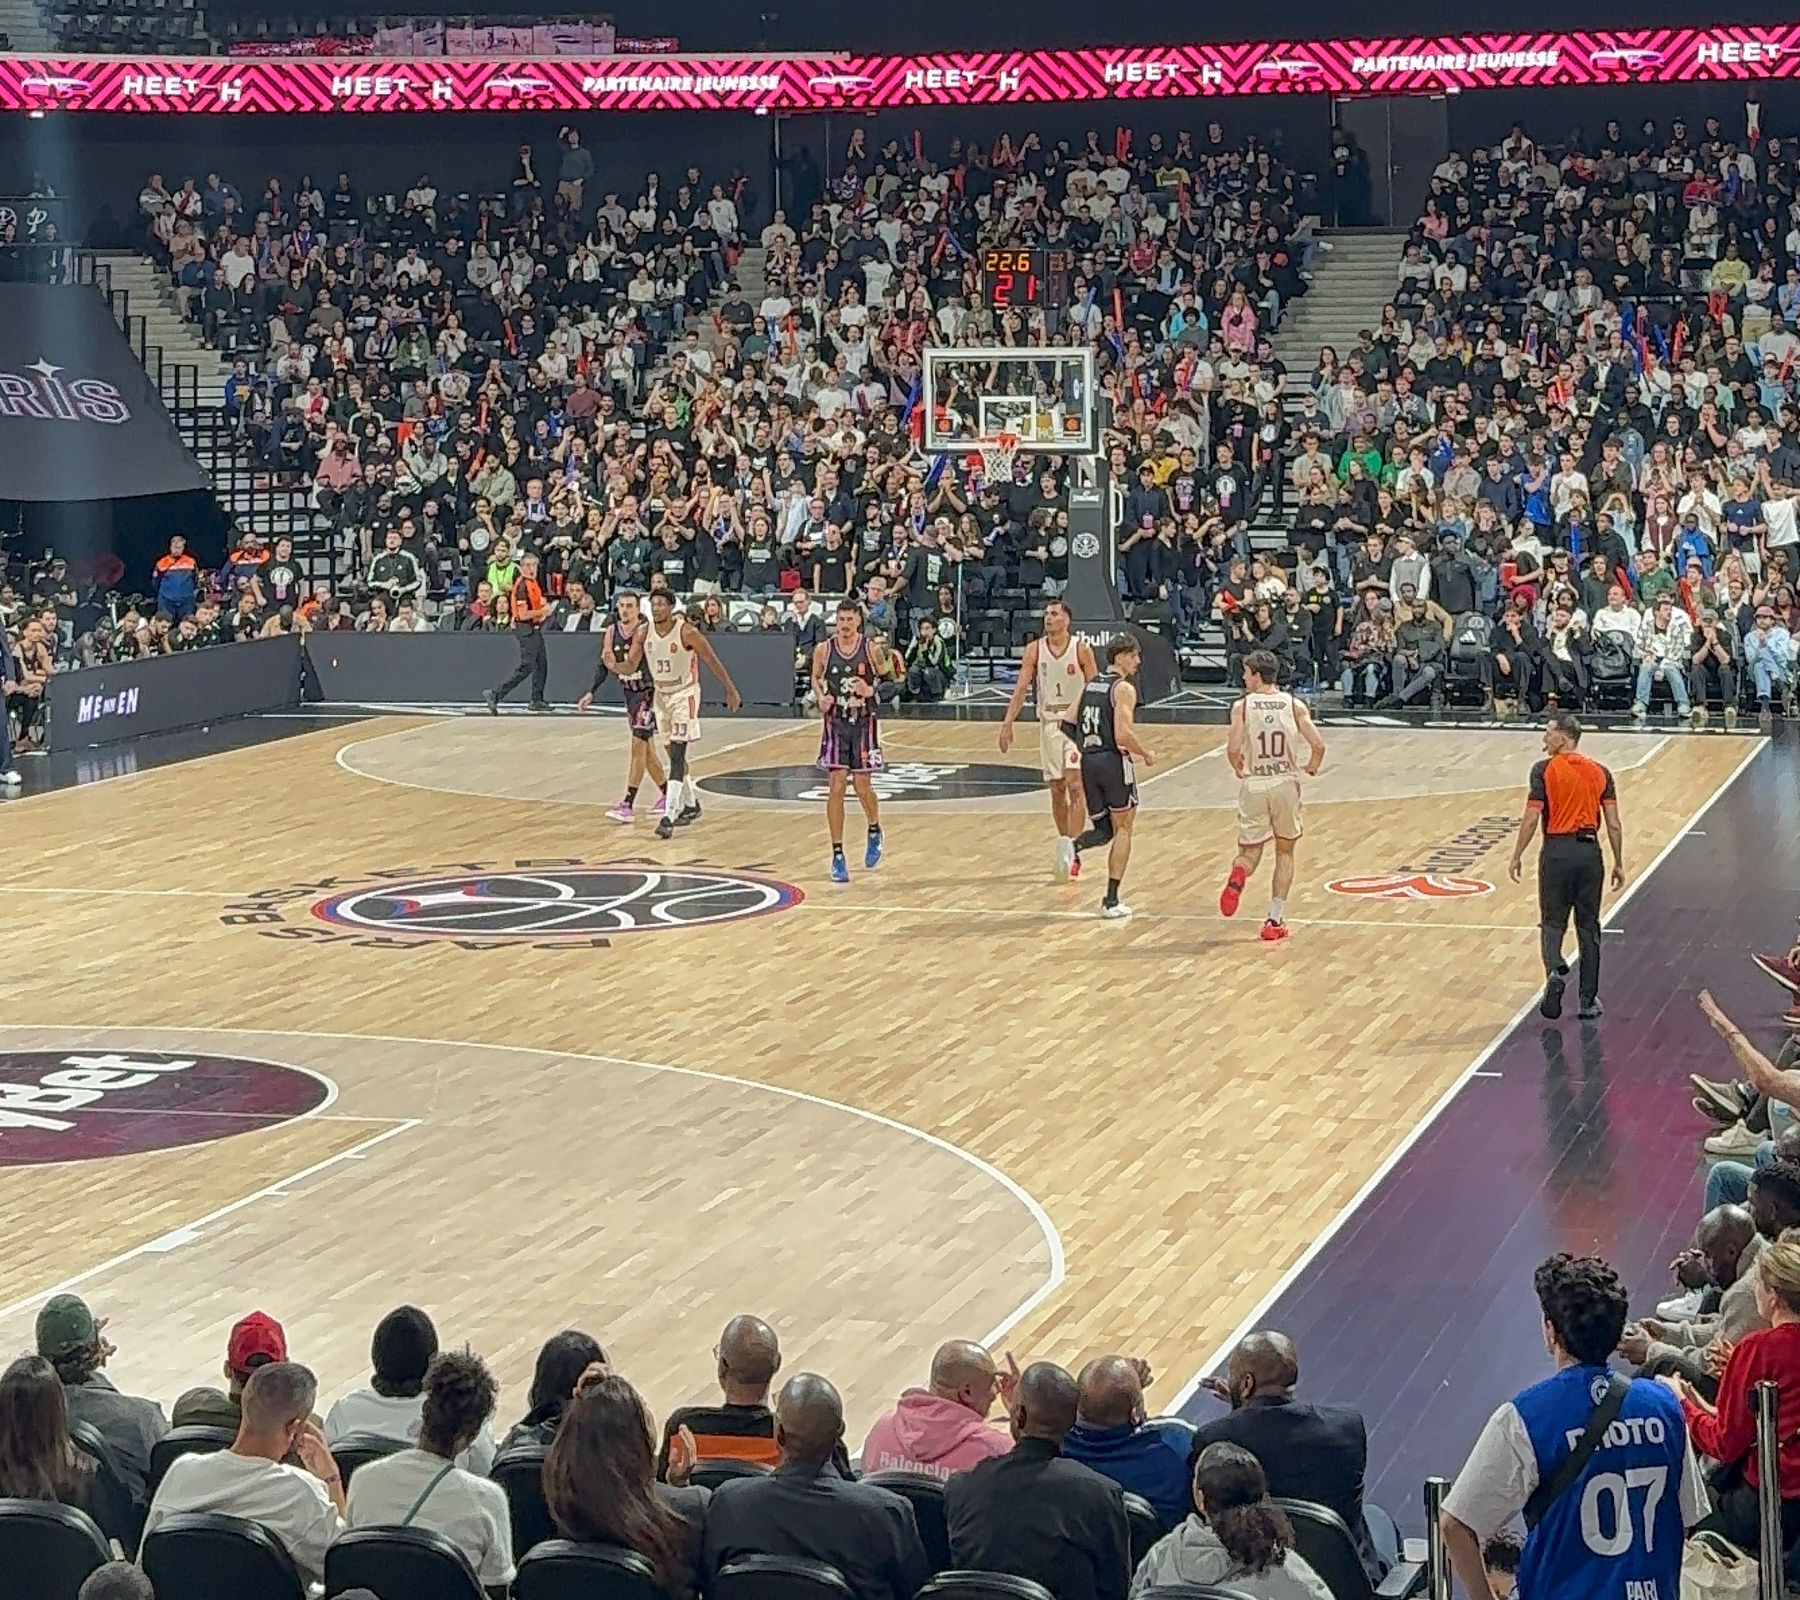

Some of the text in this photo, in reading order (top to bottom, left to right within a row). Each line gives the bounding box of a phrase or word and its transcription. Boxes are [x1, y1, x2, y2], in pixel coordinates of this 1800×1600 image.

[1352, 50, 1558, 72] PARTENAIRE JEUNESSE
[582, 75, 780, 94] PARTENAIRE JEUNESSE
[985, 253, 1030, 272] 22.6
[993, 274, 1036, 301] 21
[656, 659, 671, 673] 33
[1055, 683, 1063, 697] 1
[672, 722, 687, 737] 33
[1081, 706, 1100, 735] 34
[1257, 731, 1286, 758] 10
[220, 857, 777, 949] PARIS BASKETBALL
[880, 1451, 959, 1481] Balencia
[1580, 1465, 1668, 1557] 07
